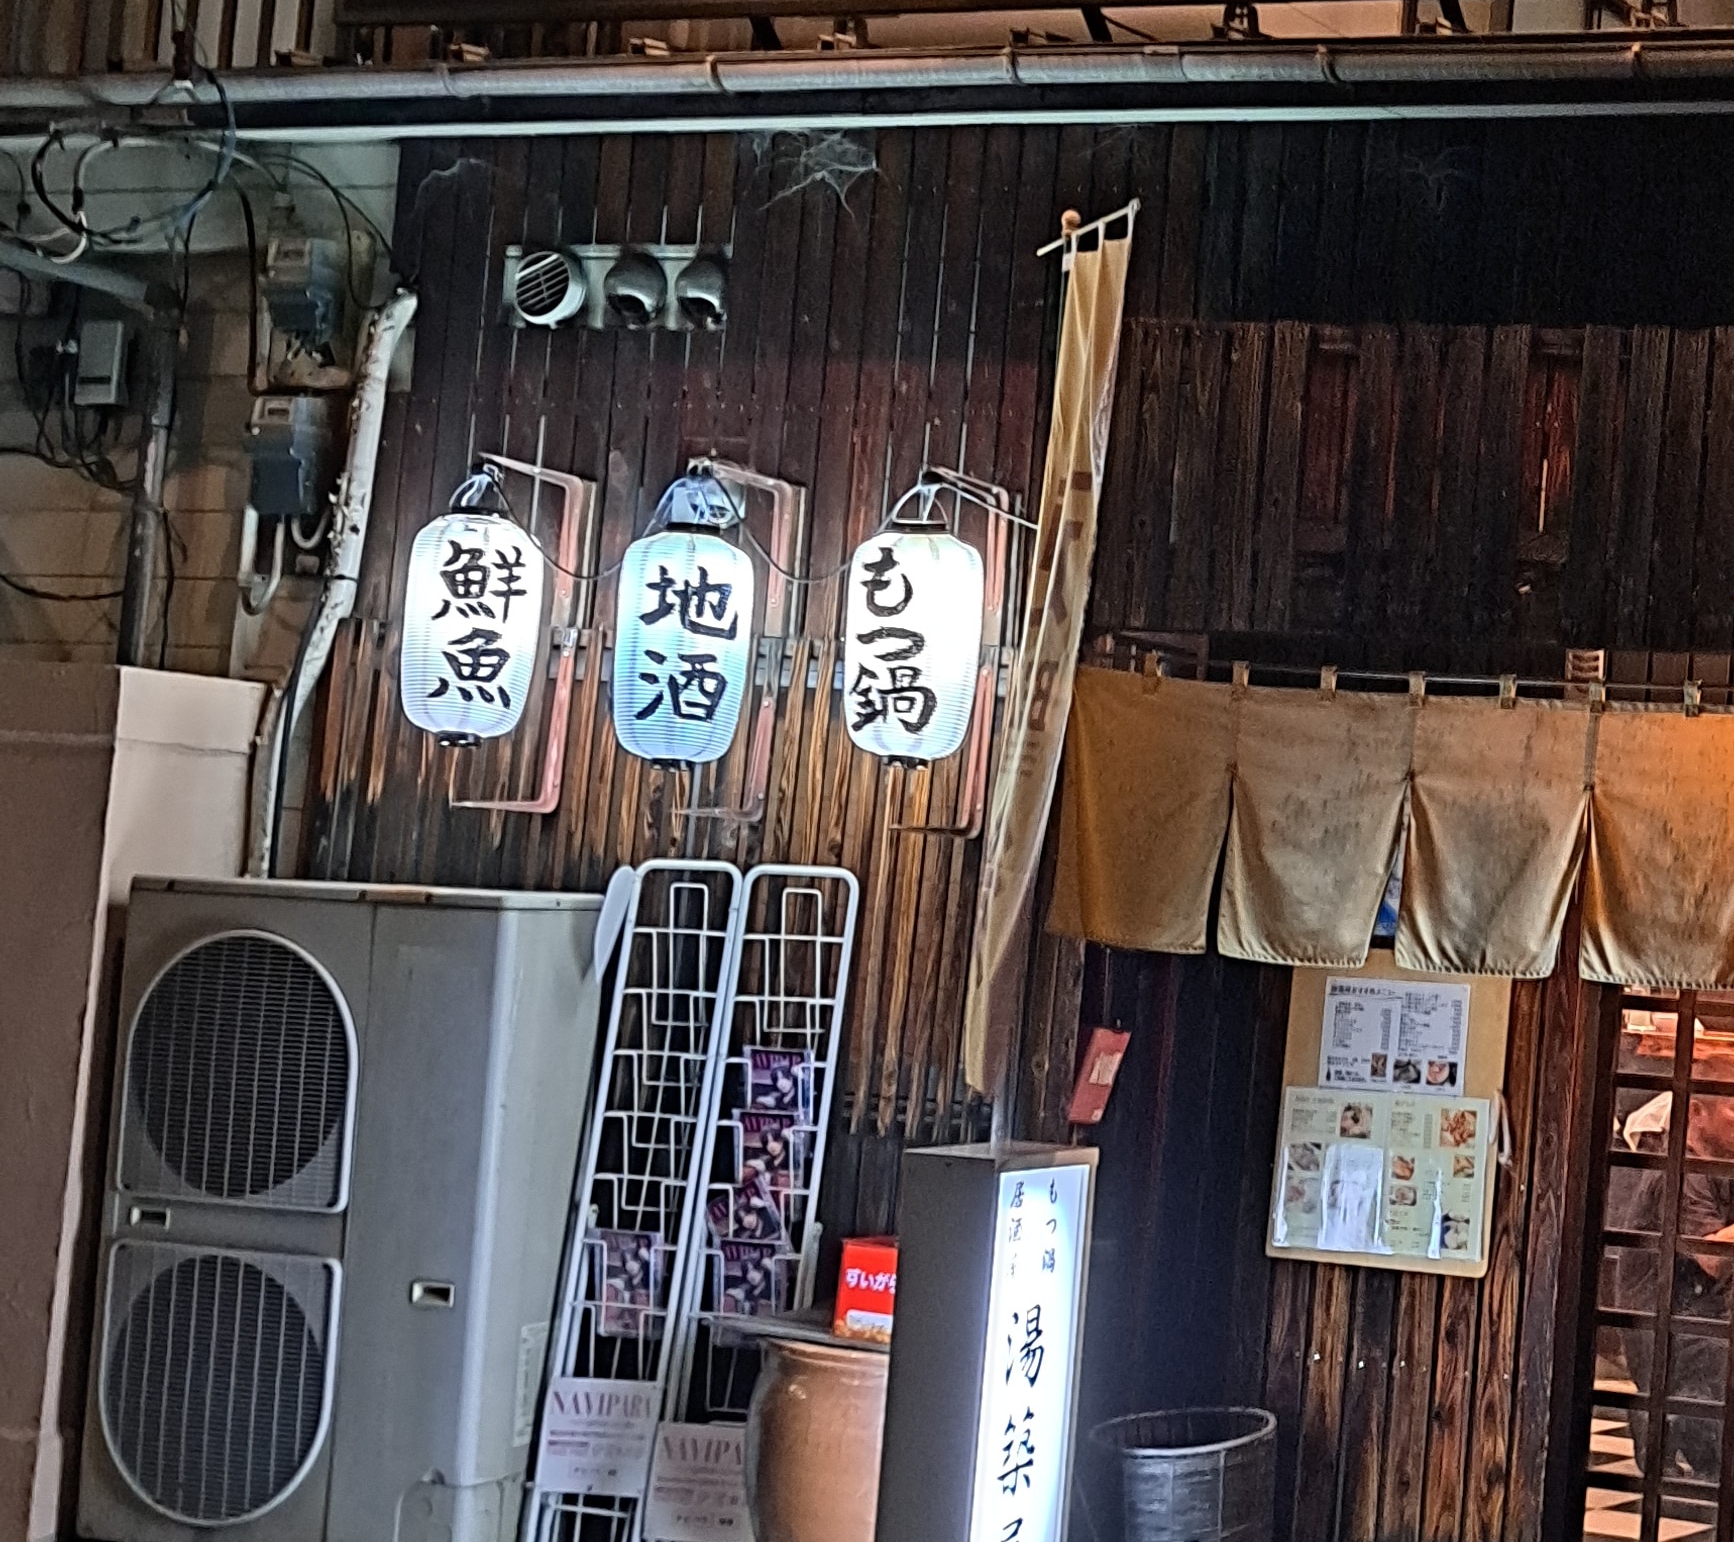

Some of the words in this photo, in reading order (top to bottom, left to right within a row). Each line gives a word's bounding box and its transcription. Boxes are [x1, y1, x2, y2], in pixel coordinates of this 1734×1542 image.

[427, 540, 528, 710] 鮮魚
[634, 566, 738, 723] 地酒
[851, 547, 937, 734] もつ鍋
